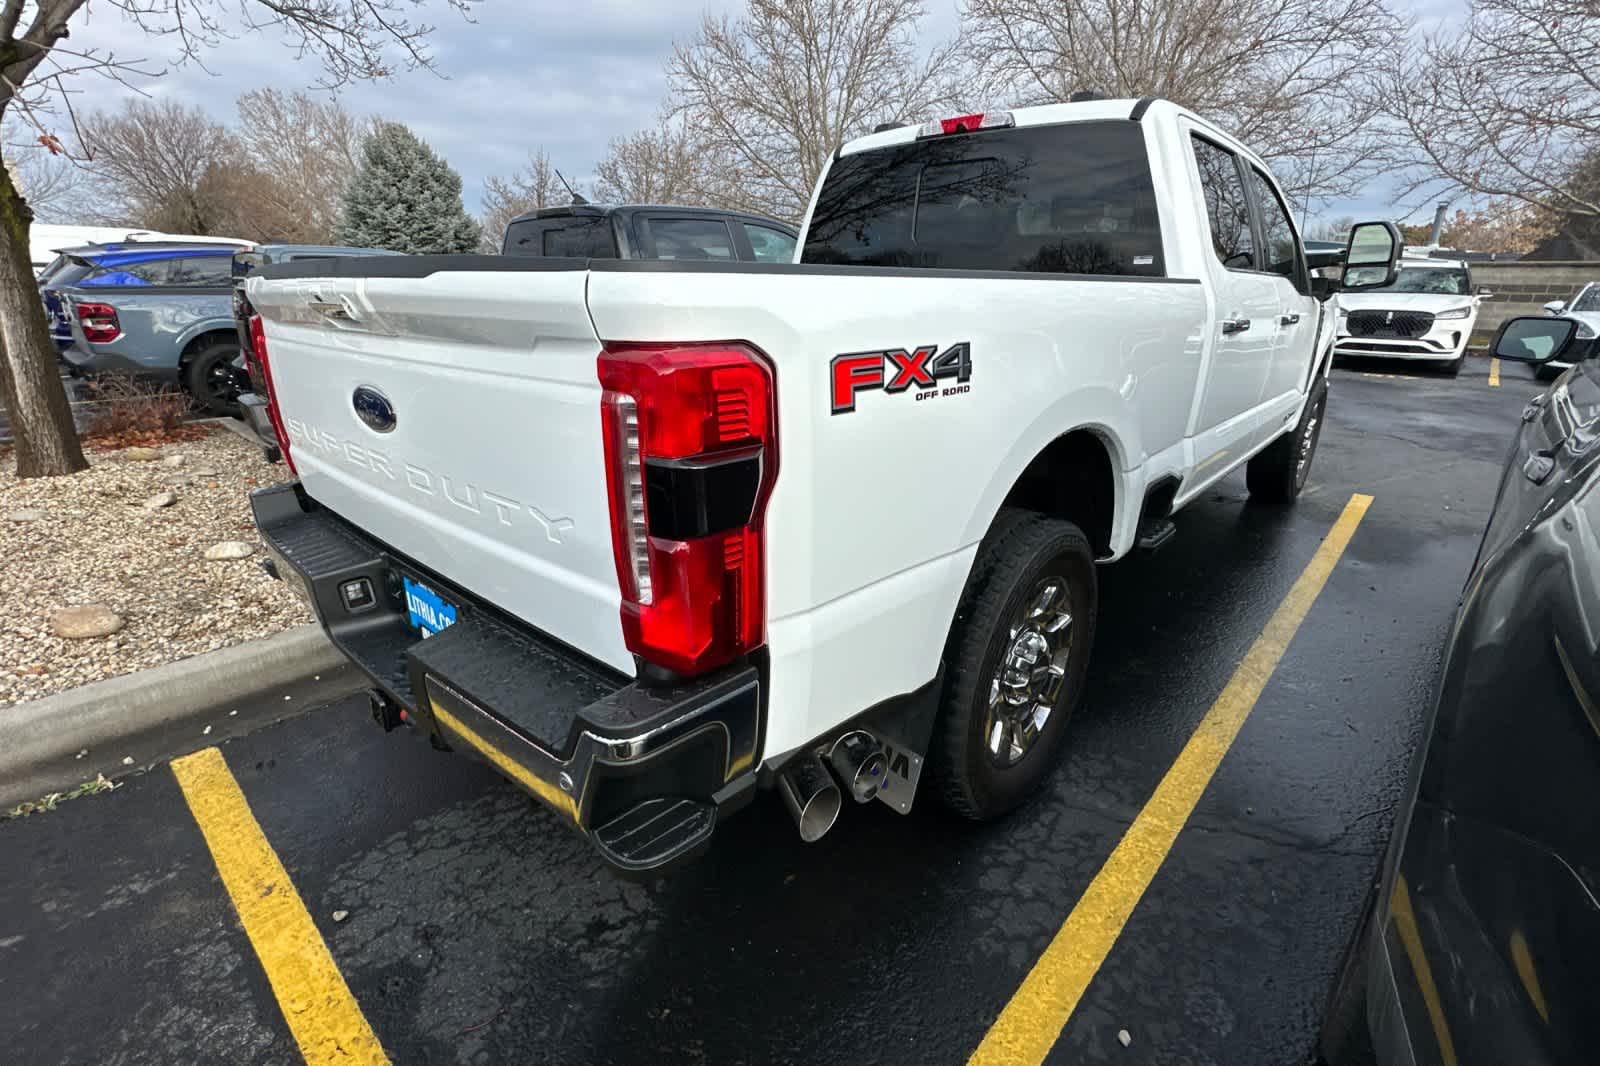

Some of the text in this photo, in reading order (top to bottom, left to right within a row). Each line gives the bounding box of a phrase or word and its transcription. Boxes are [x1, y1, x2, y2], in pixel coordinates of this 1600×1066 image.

[830, 341, 972, 416] FX4
[915, 385, 970, 401] OFF ROAD
[287, 418, 575, 544] SUPER DUTY
